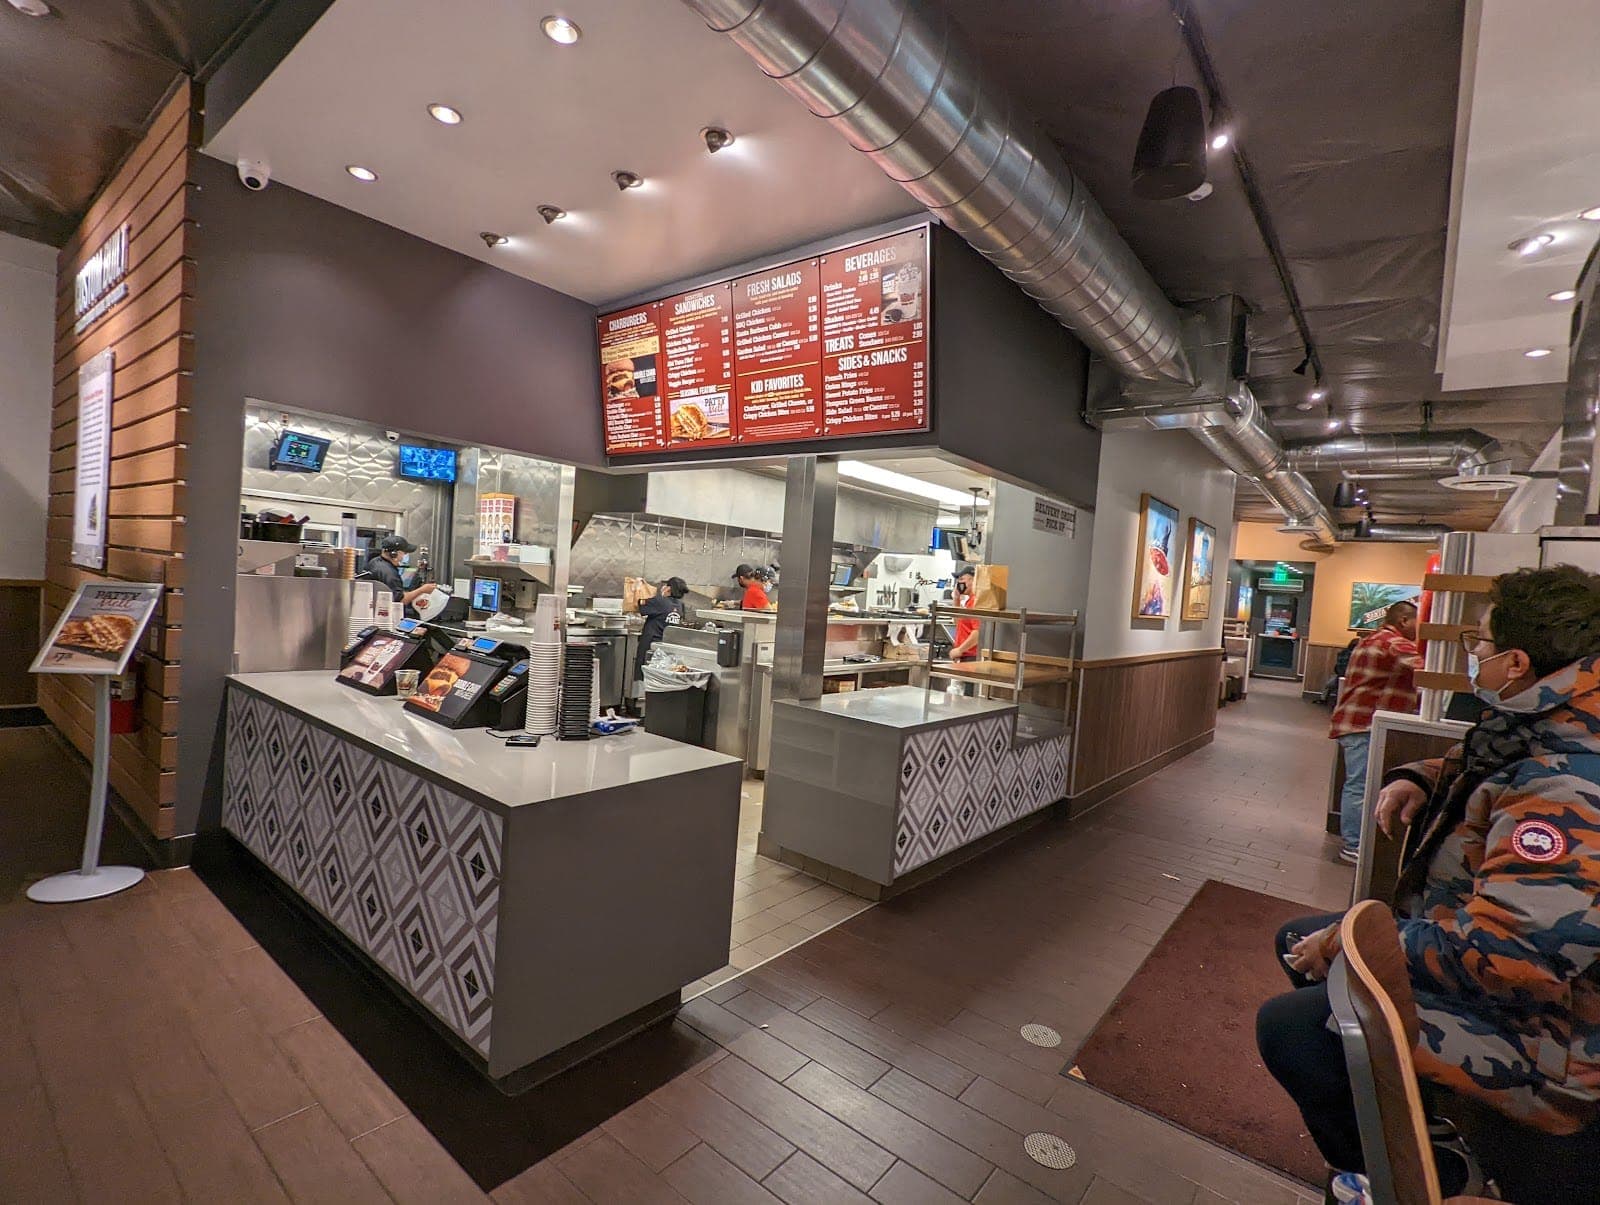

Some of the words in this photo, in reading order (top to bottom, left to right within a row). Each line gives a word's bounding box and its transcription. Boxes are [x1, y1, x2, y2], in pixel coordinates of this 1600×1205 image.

[845, 246, 896, 272] BEVERAGES
[746, 280, 770, 296] FRESH
[771, 271, 802, 290] SALADS
[674, 294, 715, 315] SANDWICHES
[825, 335, 854, 352] TREATS
[838, 355, 862, 371] SIDES
[863, 355, 870, 366] &
[871, 348, 907, 366] SNACKS
[750, 380, 763, 393] KID
[764, 374, 804, 391] FAVORITES
[1035, 502, 1060, 519] DELIVERY
[1046, 518, 1058, 530] PICK
[1058, 522, 1065, 532] UP
